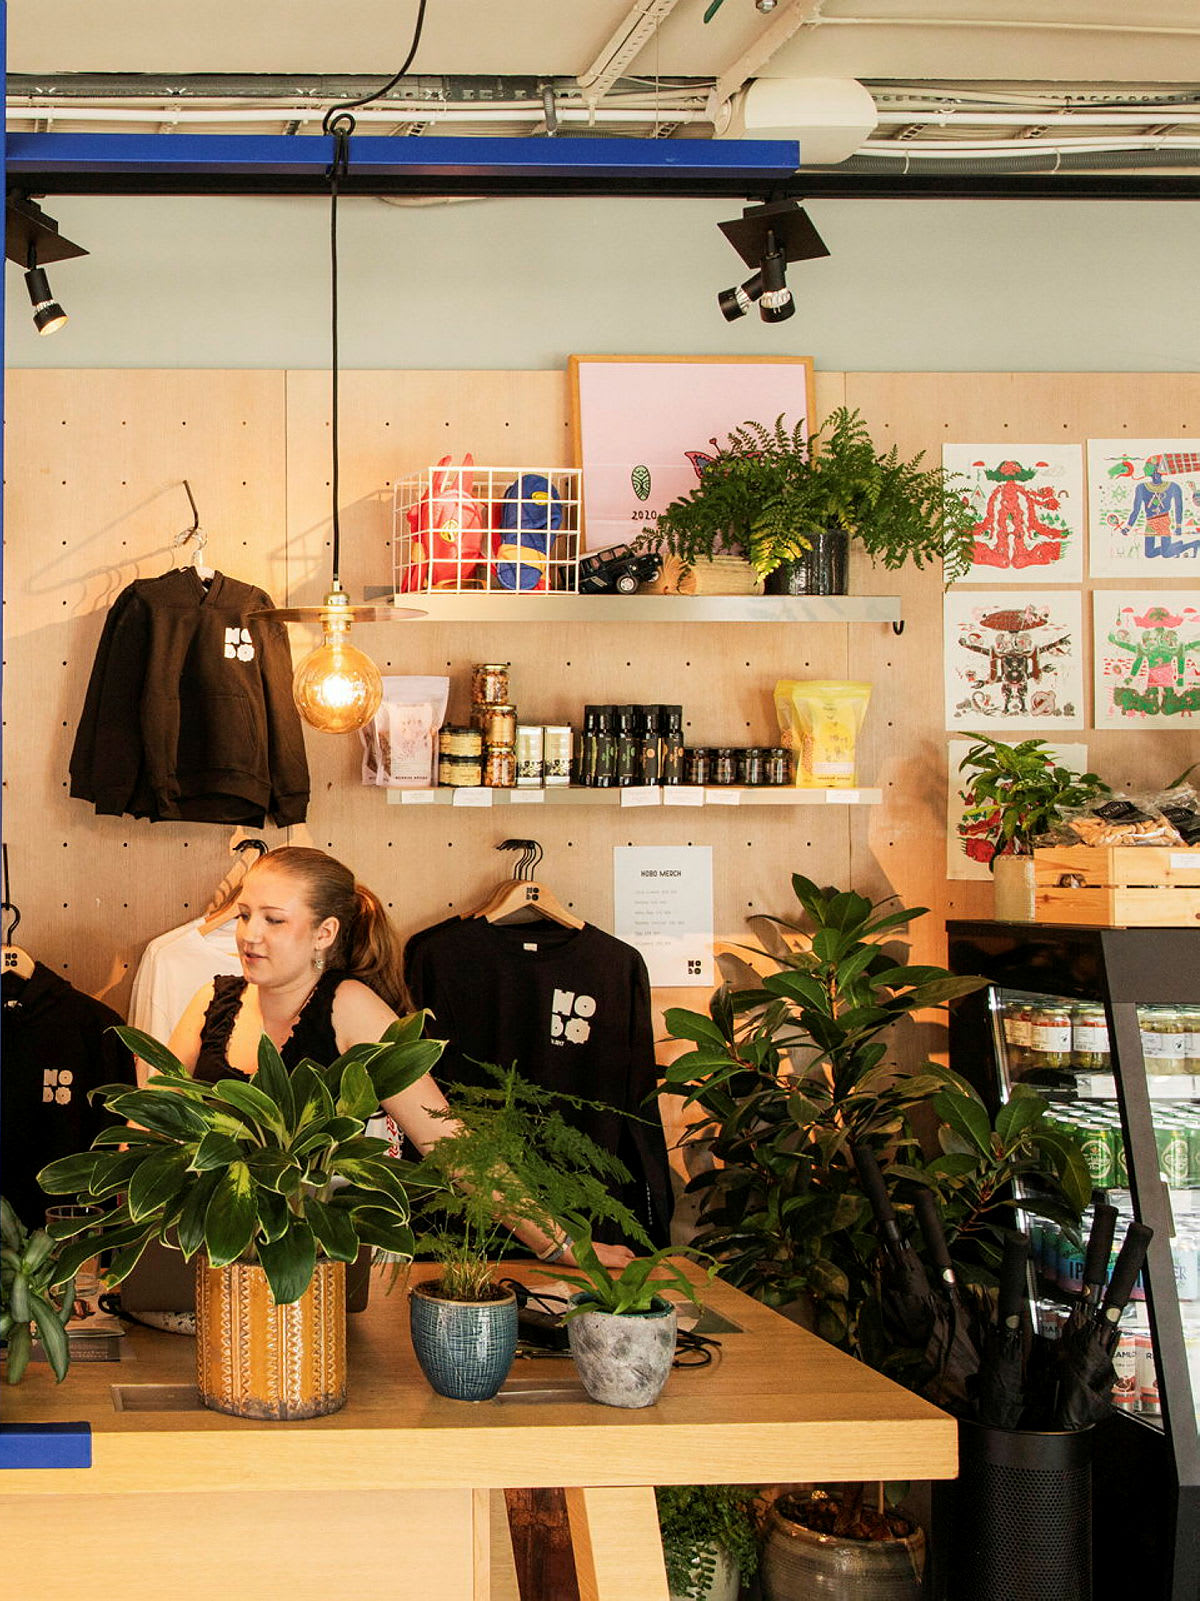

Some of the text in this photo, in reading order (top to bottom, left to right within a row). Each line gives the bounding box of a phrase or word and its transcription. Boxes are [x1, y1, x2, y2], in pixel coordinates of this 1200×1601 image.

[631, 509, 658, 521] 2020
[640, 869, 682, 878] HOBO MERCH
